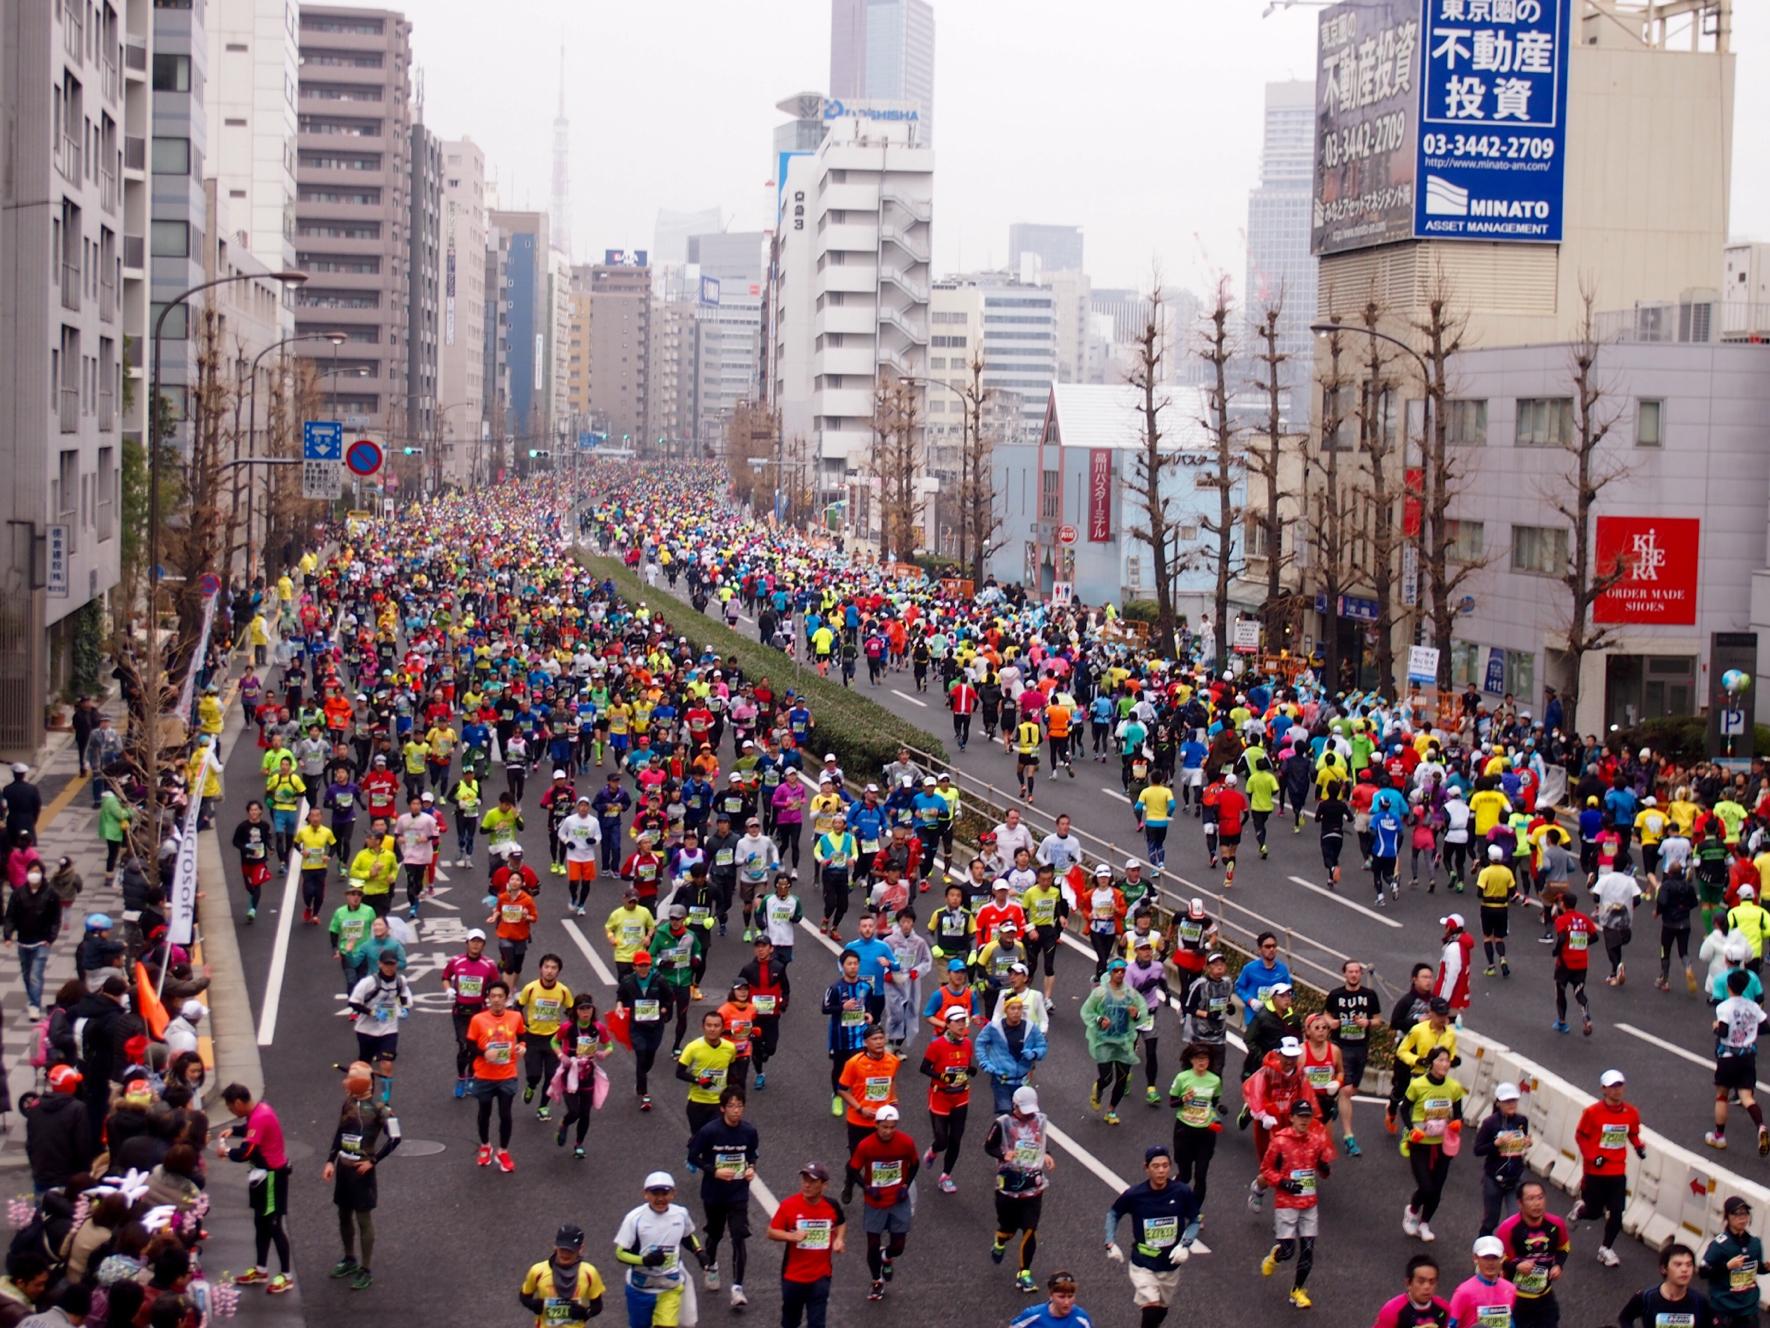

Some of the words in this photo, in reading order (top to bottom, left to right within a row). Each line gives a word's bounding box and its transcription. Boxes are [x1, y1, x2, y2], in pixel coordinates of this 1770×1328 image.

[1431, 27, 1553, 73] 不動産
[1323, 20, 1417, 117] 不動産投資
[1445, 74, 1532, 121] 投資
[1325, 112, 1405, 168] 03-3442-2709
[1423, 133, 1554, 160] 03-3442-2709
[1470, 199, 1550, 219] MINATO
[1425, 220, 1465, 232] ASSET
[1467, 222, 1549, 235] MANAGEMENT
[1094, 452, 1107, 538] 品川バスターミナル
[1606, 588, 1647, 599] ORDER
[1651, 590, 1685, 600] MADE
[1625, 601, 1665, 612] SHOES
[1338, 995, 1368, 1008] RUN
